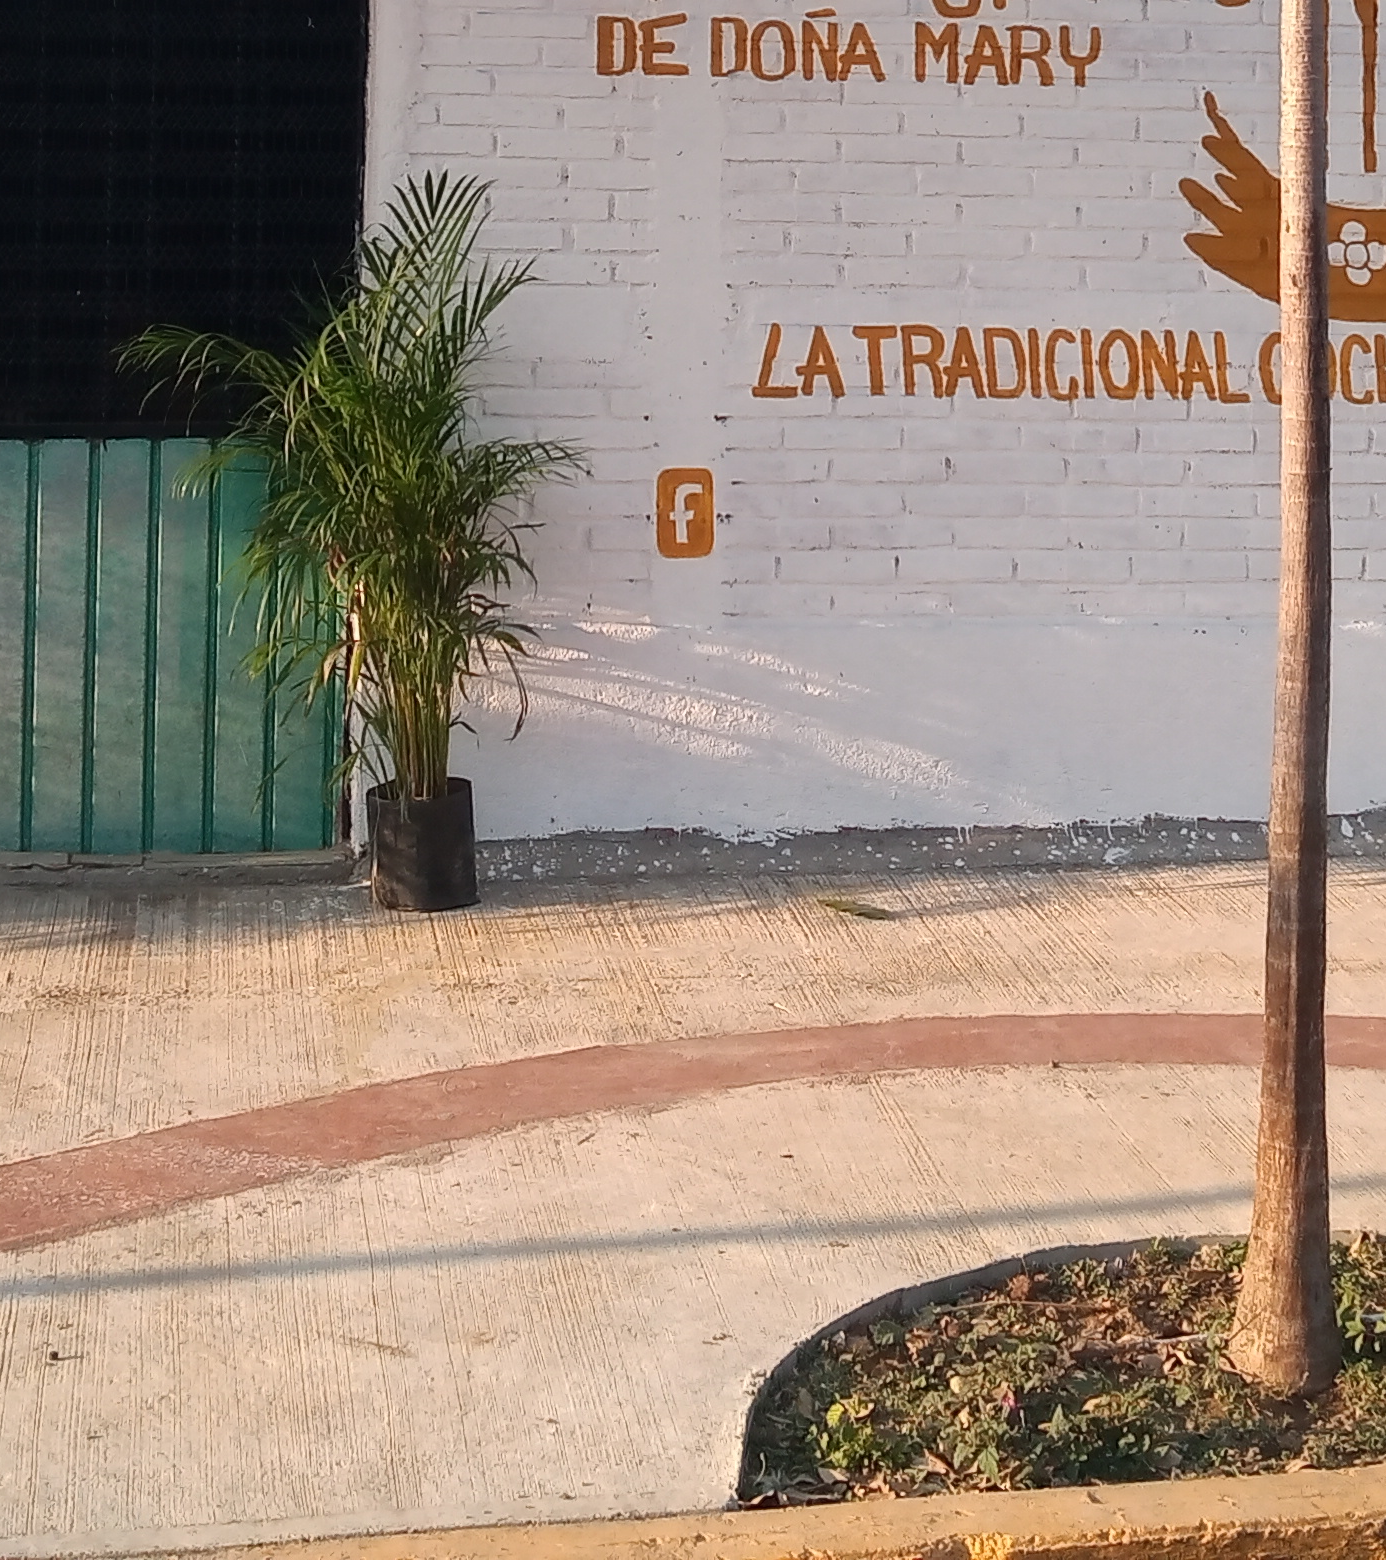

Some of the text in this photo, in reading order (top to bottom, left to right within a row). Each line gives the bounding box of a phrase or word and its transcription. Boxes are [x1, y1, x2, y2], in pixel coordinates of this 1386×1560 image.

[596, 8, 1102, 87] DE DOÑA MARY
[751, 322, 846, 399] LA
[852, 324, 1251, 404] TRADICIONAL
